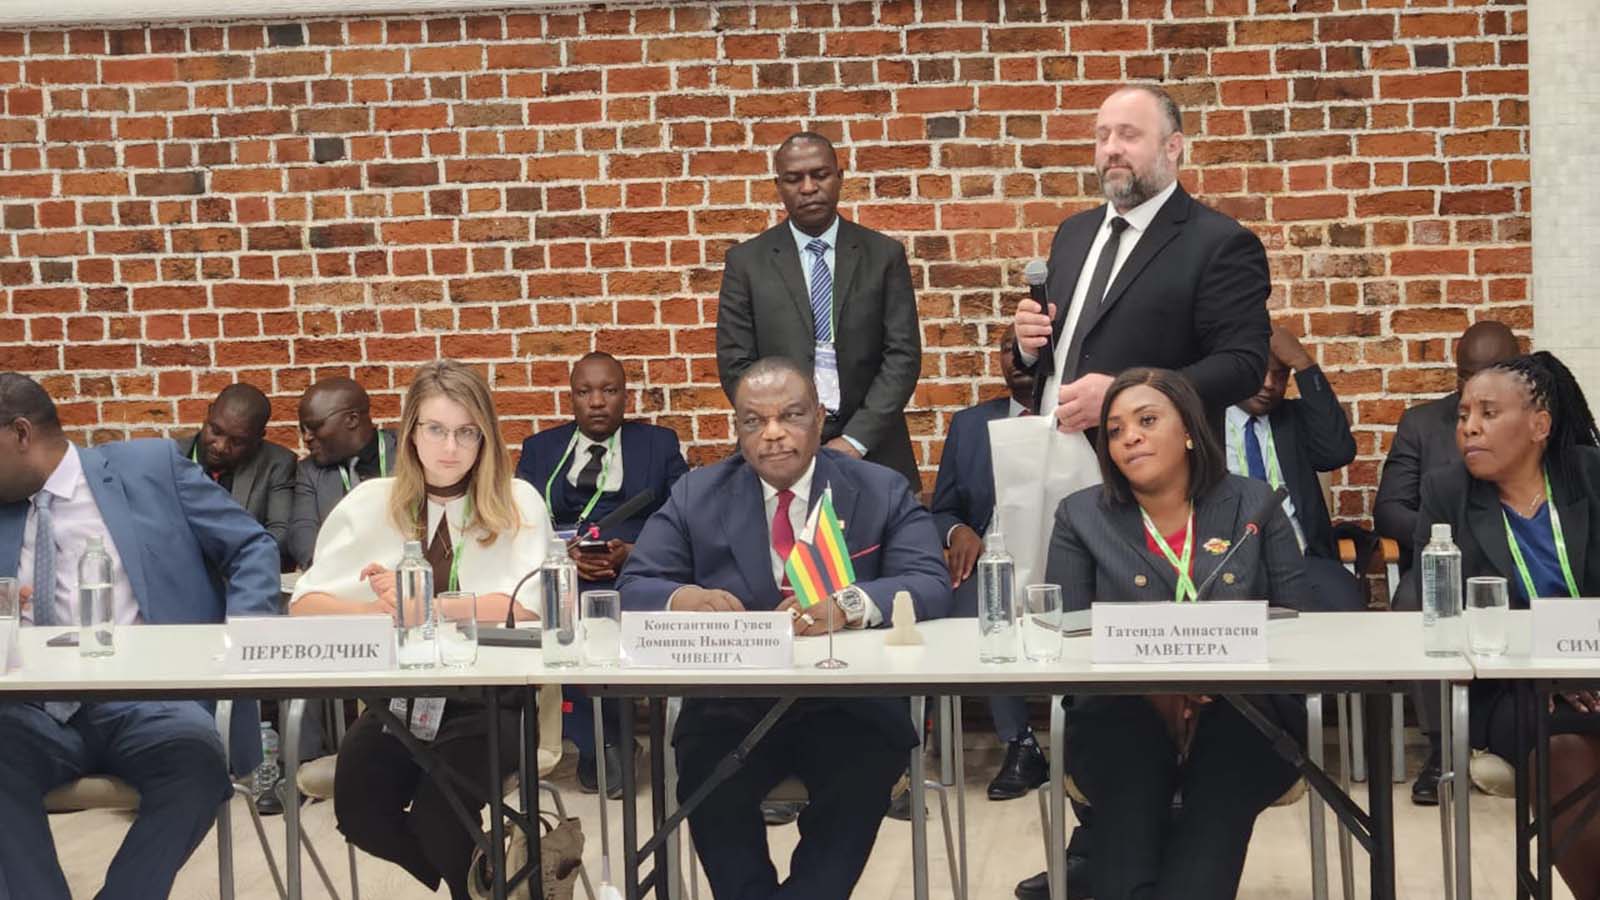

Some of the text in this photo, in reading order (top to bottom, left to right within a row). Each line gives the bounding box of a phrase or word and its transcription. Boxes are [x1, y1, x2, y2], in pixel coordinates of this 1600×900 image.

[644, 619, 773, 632] Константино Гувея
[1105, 625, 1259, 638] Татенда Аннастасия
[635, 635, 780, 649] Доминик Ньикадзино
[1556, 639, 1599, 653] СИМ
[242, 643, 380, 661] ПЕРЕВОДЧИК
[1135, 643, 1229, 656] МАВЕТЕРА
[671, 652, 743, 664] ЧИВЕНГА
